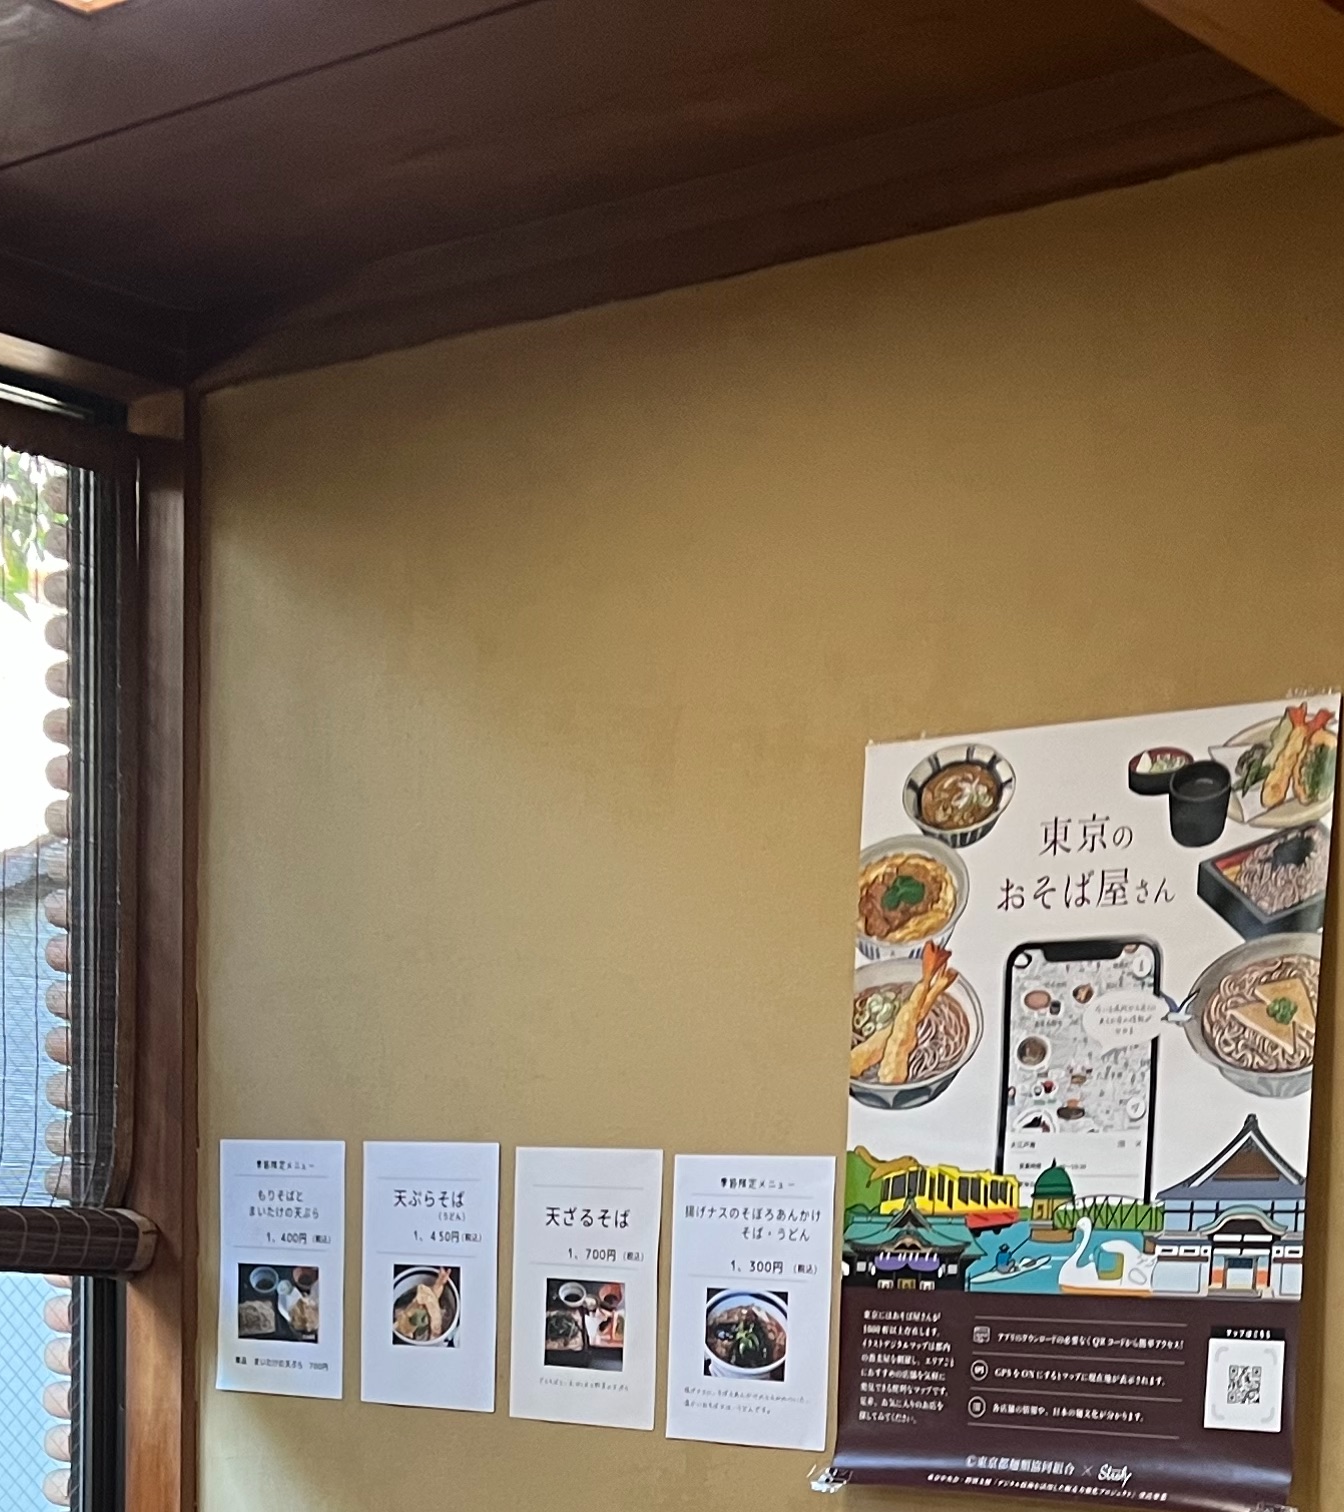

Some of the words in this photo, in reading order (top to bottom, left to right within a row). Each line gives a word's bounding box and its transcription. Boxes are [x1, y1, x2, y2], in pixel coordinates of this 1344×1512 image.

[1039, 813, 1133, 856] 東京の
[997, 868, 1176, 912] おそば屋さん
[258, 1190, 304, 1202] もりそばと
[393, 1189, 465, 1208] 天ぷらそば
[249, 1206, 319, 1219] まいたけの天ぷら
[545, 1206, 630, 1228] 天ざるそば
[685, 1205, 821, 1222] 揚げナスのそぼろあんかけ
[742, 1227, 810, 1242] そば・うどん
